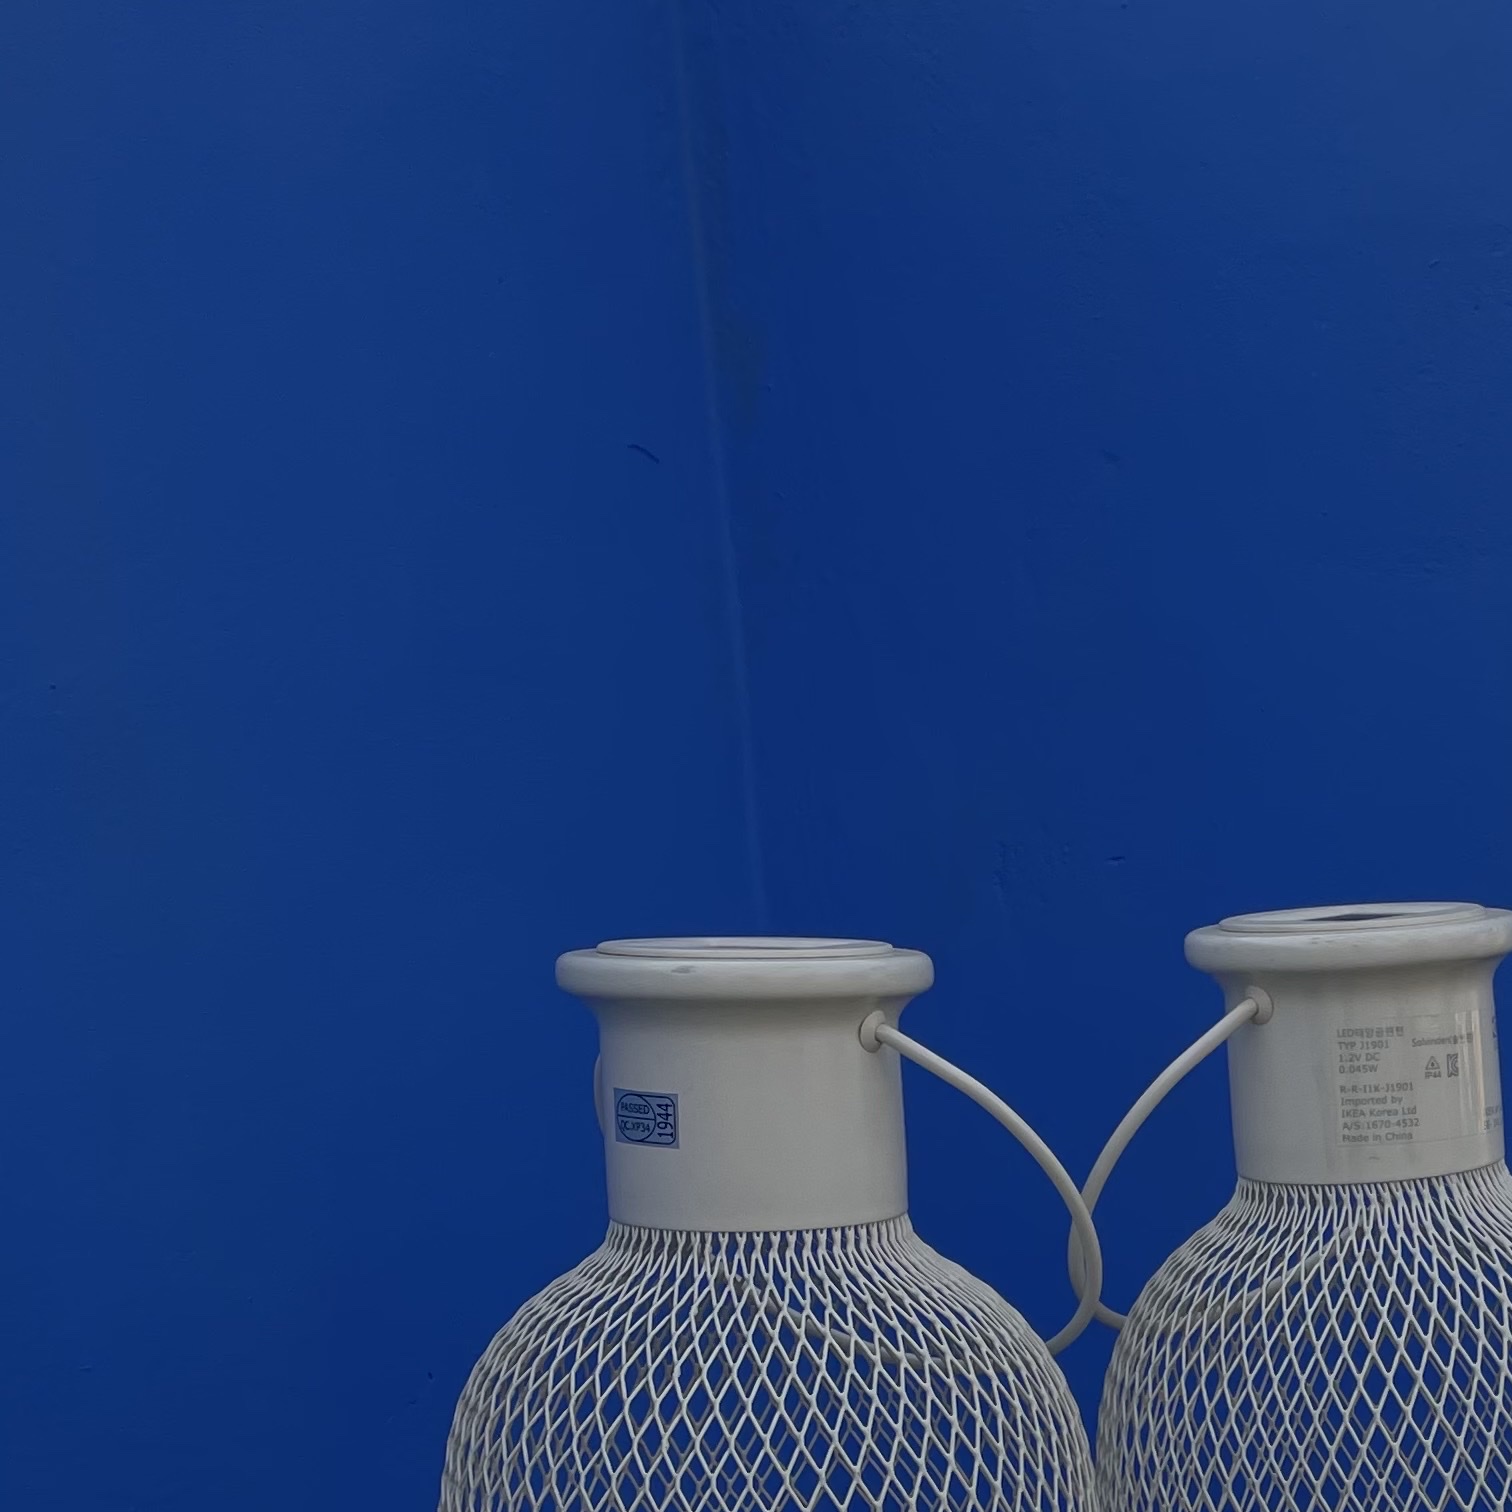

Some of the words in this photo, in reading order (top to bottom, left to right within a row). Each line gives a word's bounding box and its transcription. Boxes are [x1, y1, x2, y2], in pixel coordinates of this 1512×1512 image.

[1365, 1052, 1381, 1062] DC
[1341, 1096, 1387, 1107] Imported
[1391, 1095, 1403, 1105] by
[1342, 1109, 1366, 1118] IKEA
[1369, 1108, 1398, 1117] Korea
[1402, 1105, 1417, 1115] Ltd
[656, 1103, 674, 1138] 1944
[1342, 1134, 1369, 1143] Made
[1372, 1133, 1382, 1141] in
[1385, 1132, 1413, 1141] China
